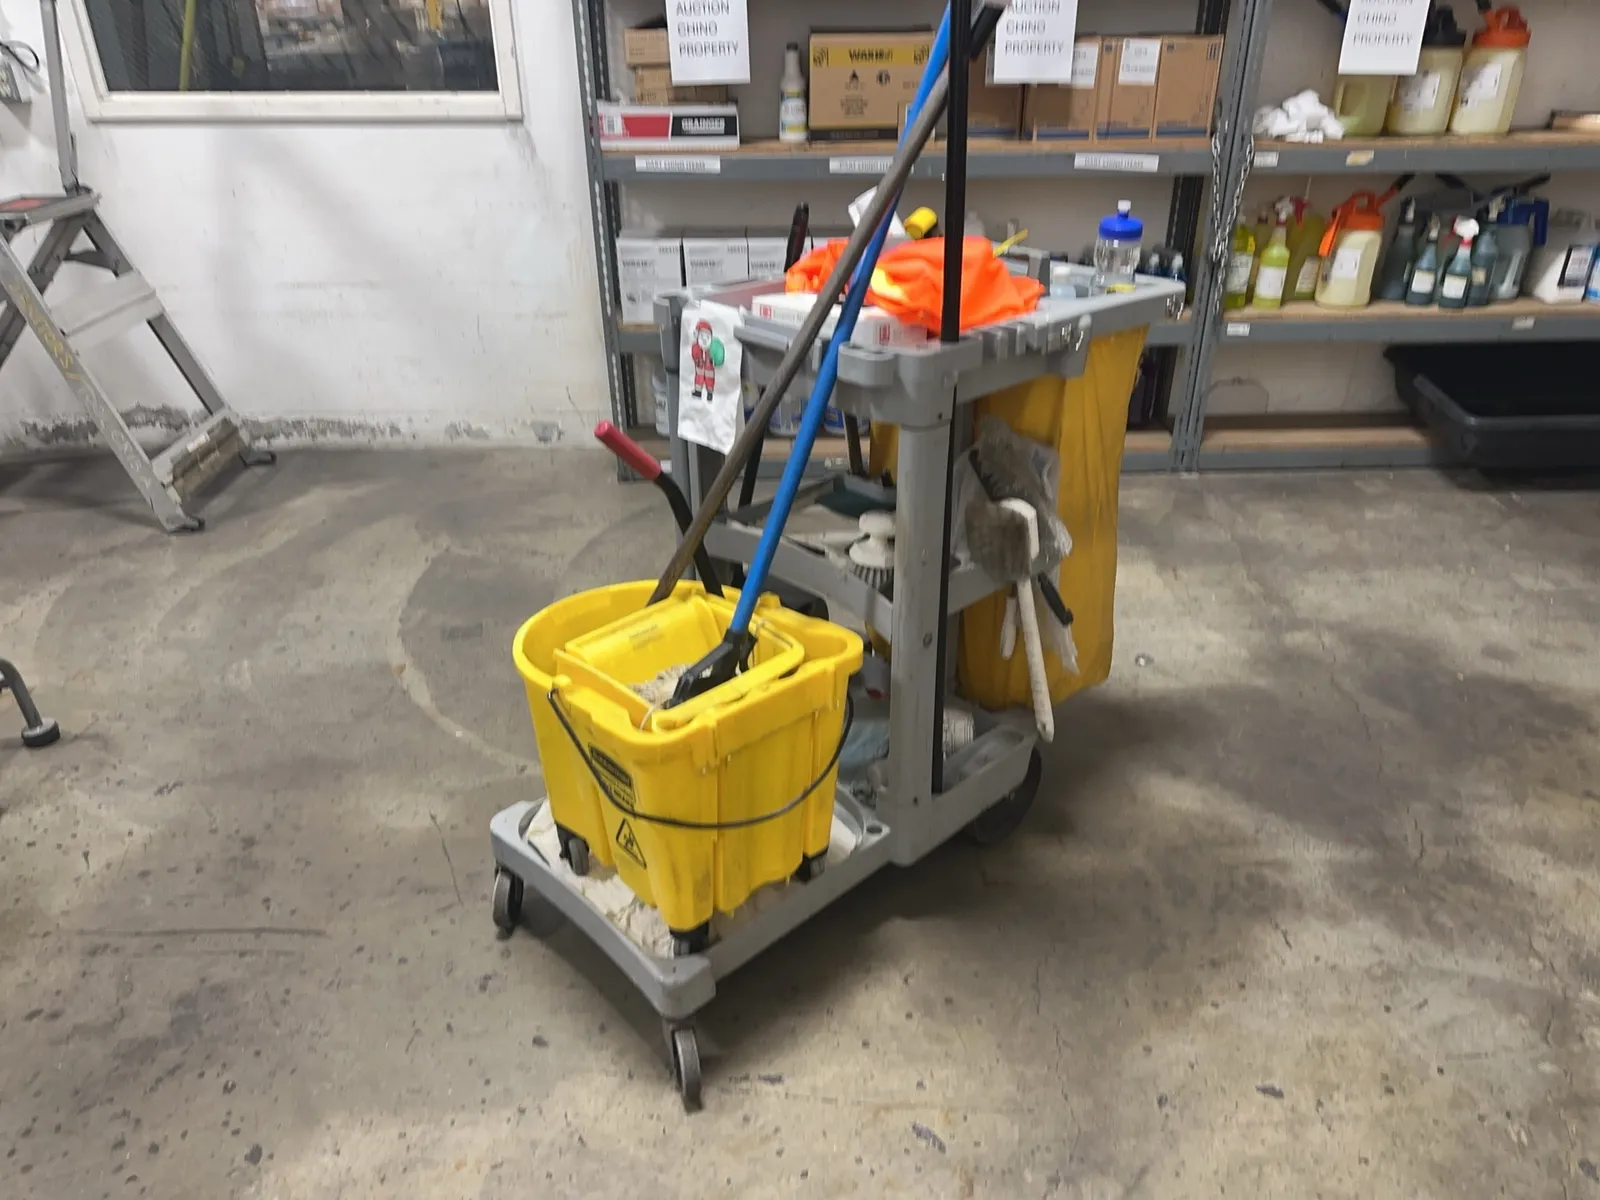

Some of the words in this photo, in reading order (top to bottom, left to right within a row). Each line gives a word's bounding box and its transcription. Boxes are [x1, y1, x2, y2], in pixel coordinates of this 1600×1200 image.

[676, 0, 730, 16] AUCTION
[677, 20, 718, 37] CHINO
[1006, 19, 1046, 35] CHINO
[679, 40, 739, 58] PROPERTY
[1005, 40, 1064, 56] PROPERTY
